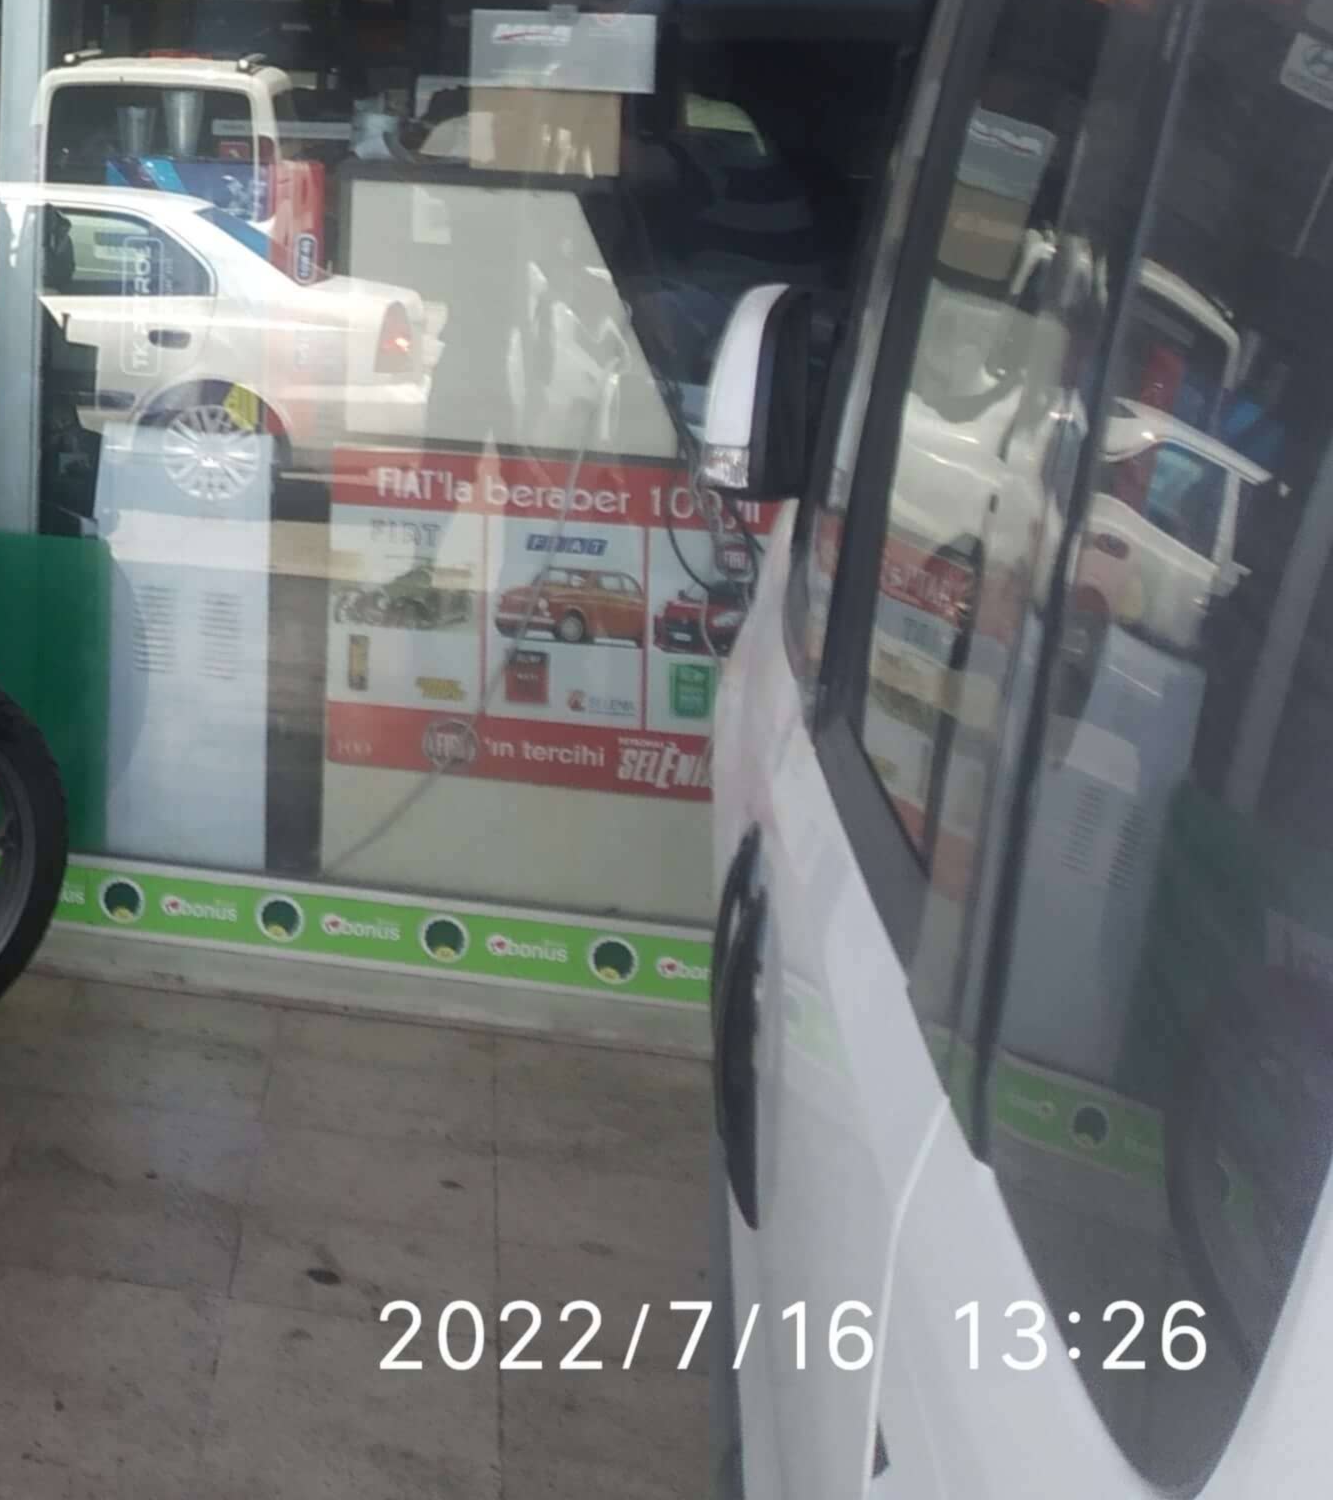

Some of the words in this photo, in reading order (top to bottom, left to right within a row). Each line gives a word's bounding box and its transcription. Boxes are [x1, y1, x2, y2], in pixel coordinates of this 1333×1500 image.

[376, 467, 474, 505] FIAT'la
[486, 475, 631, 515] beraber
[520, 740, 606, 769] tercihi
